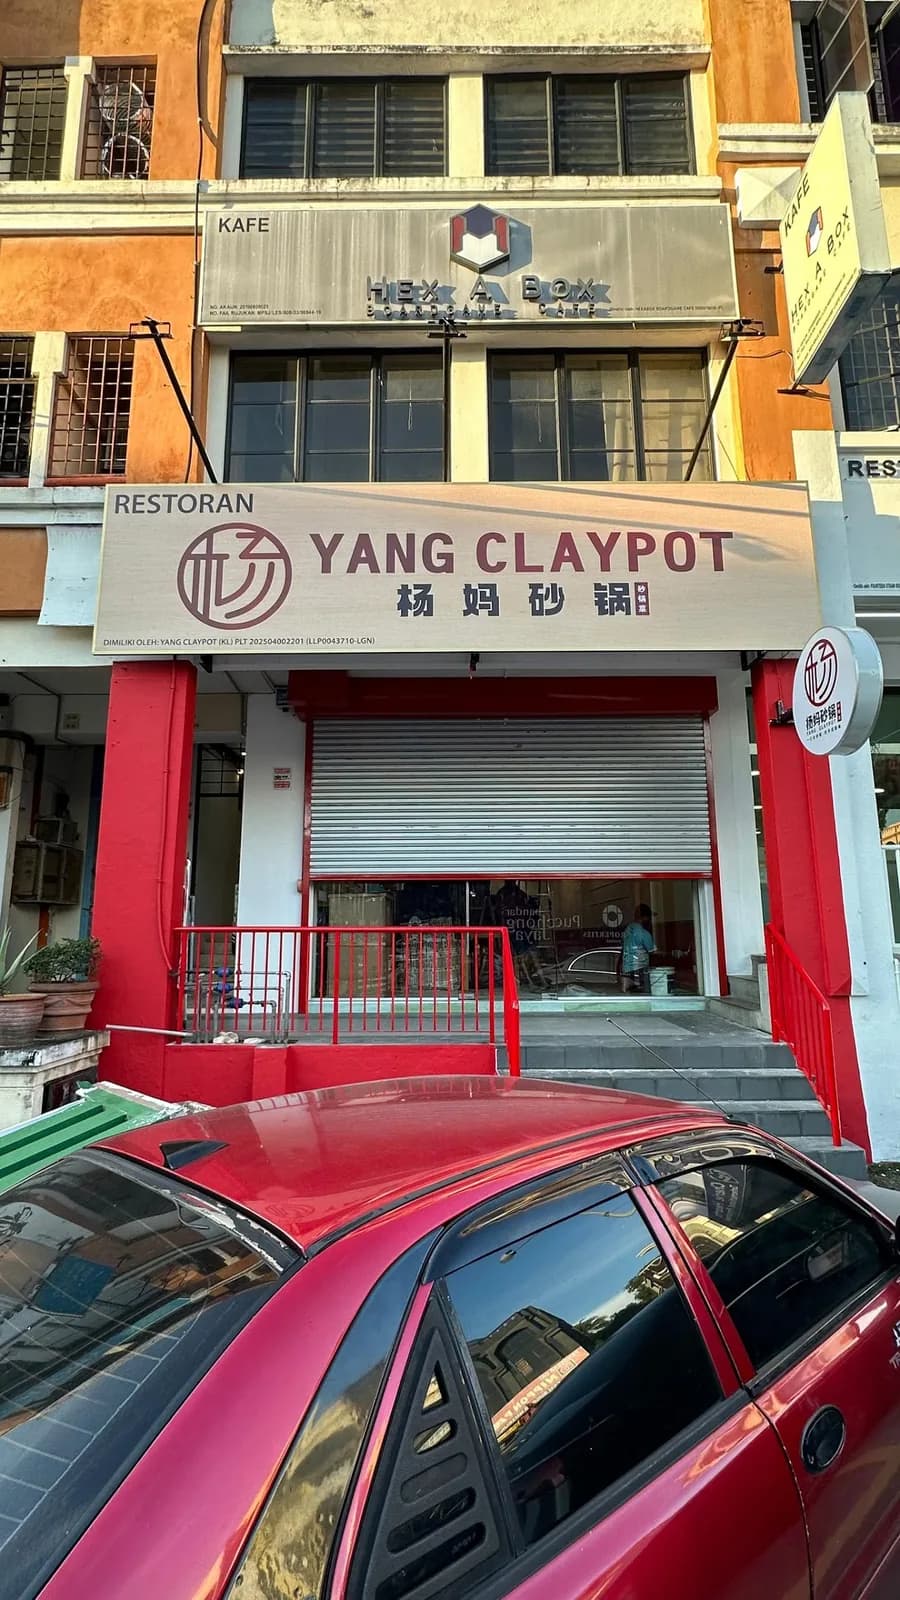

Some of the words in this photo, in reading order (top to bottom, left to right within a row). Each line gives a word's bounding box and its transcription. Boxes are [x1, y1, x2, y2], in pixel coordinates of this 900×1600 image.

[784, 171, 811, 238] KAFE
[218, 217, 270, 233] KAFE
[791, 282, 811, 324] HEX
[814, 260, 823, 281] A
[826, 204, 850, 255] BOX
[366, 275, 439, 301] HEX
[470, 275, 492, 302] A
[522, 274, 595, 301] BOX
[539, 303, 596, 318] CAFE
[114, 493, 254, 514] RESTORAN
[309, 532, 455, 574] YANG
[475, 531, 734, 573] CLAYPOT
[396, 582, 632, 617] 杨妈砂锅
[103, 638, 135, 646] DIMILIKI
[135, 638, 160, 646] OLEH:
[160, 638, 182, 646] YANG
[182, 638, 218, 646] CLAYPOT
[218, 638, 233, 647] (KL)
[249, 637, 304, 645] 202504002201
[305, 637, 376, 646] (LLP0043710-LGN)
